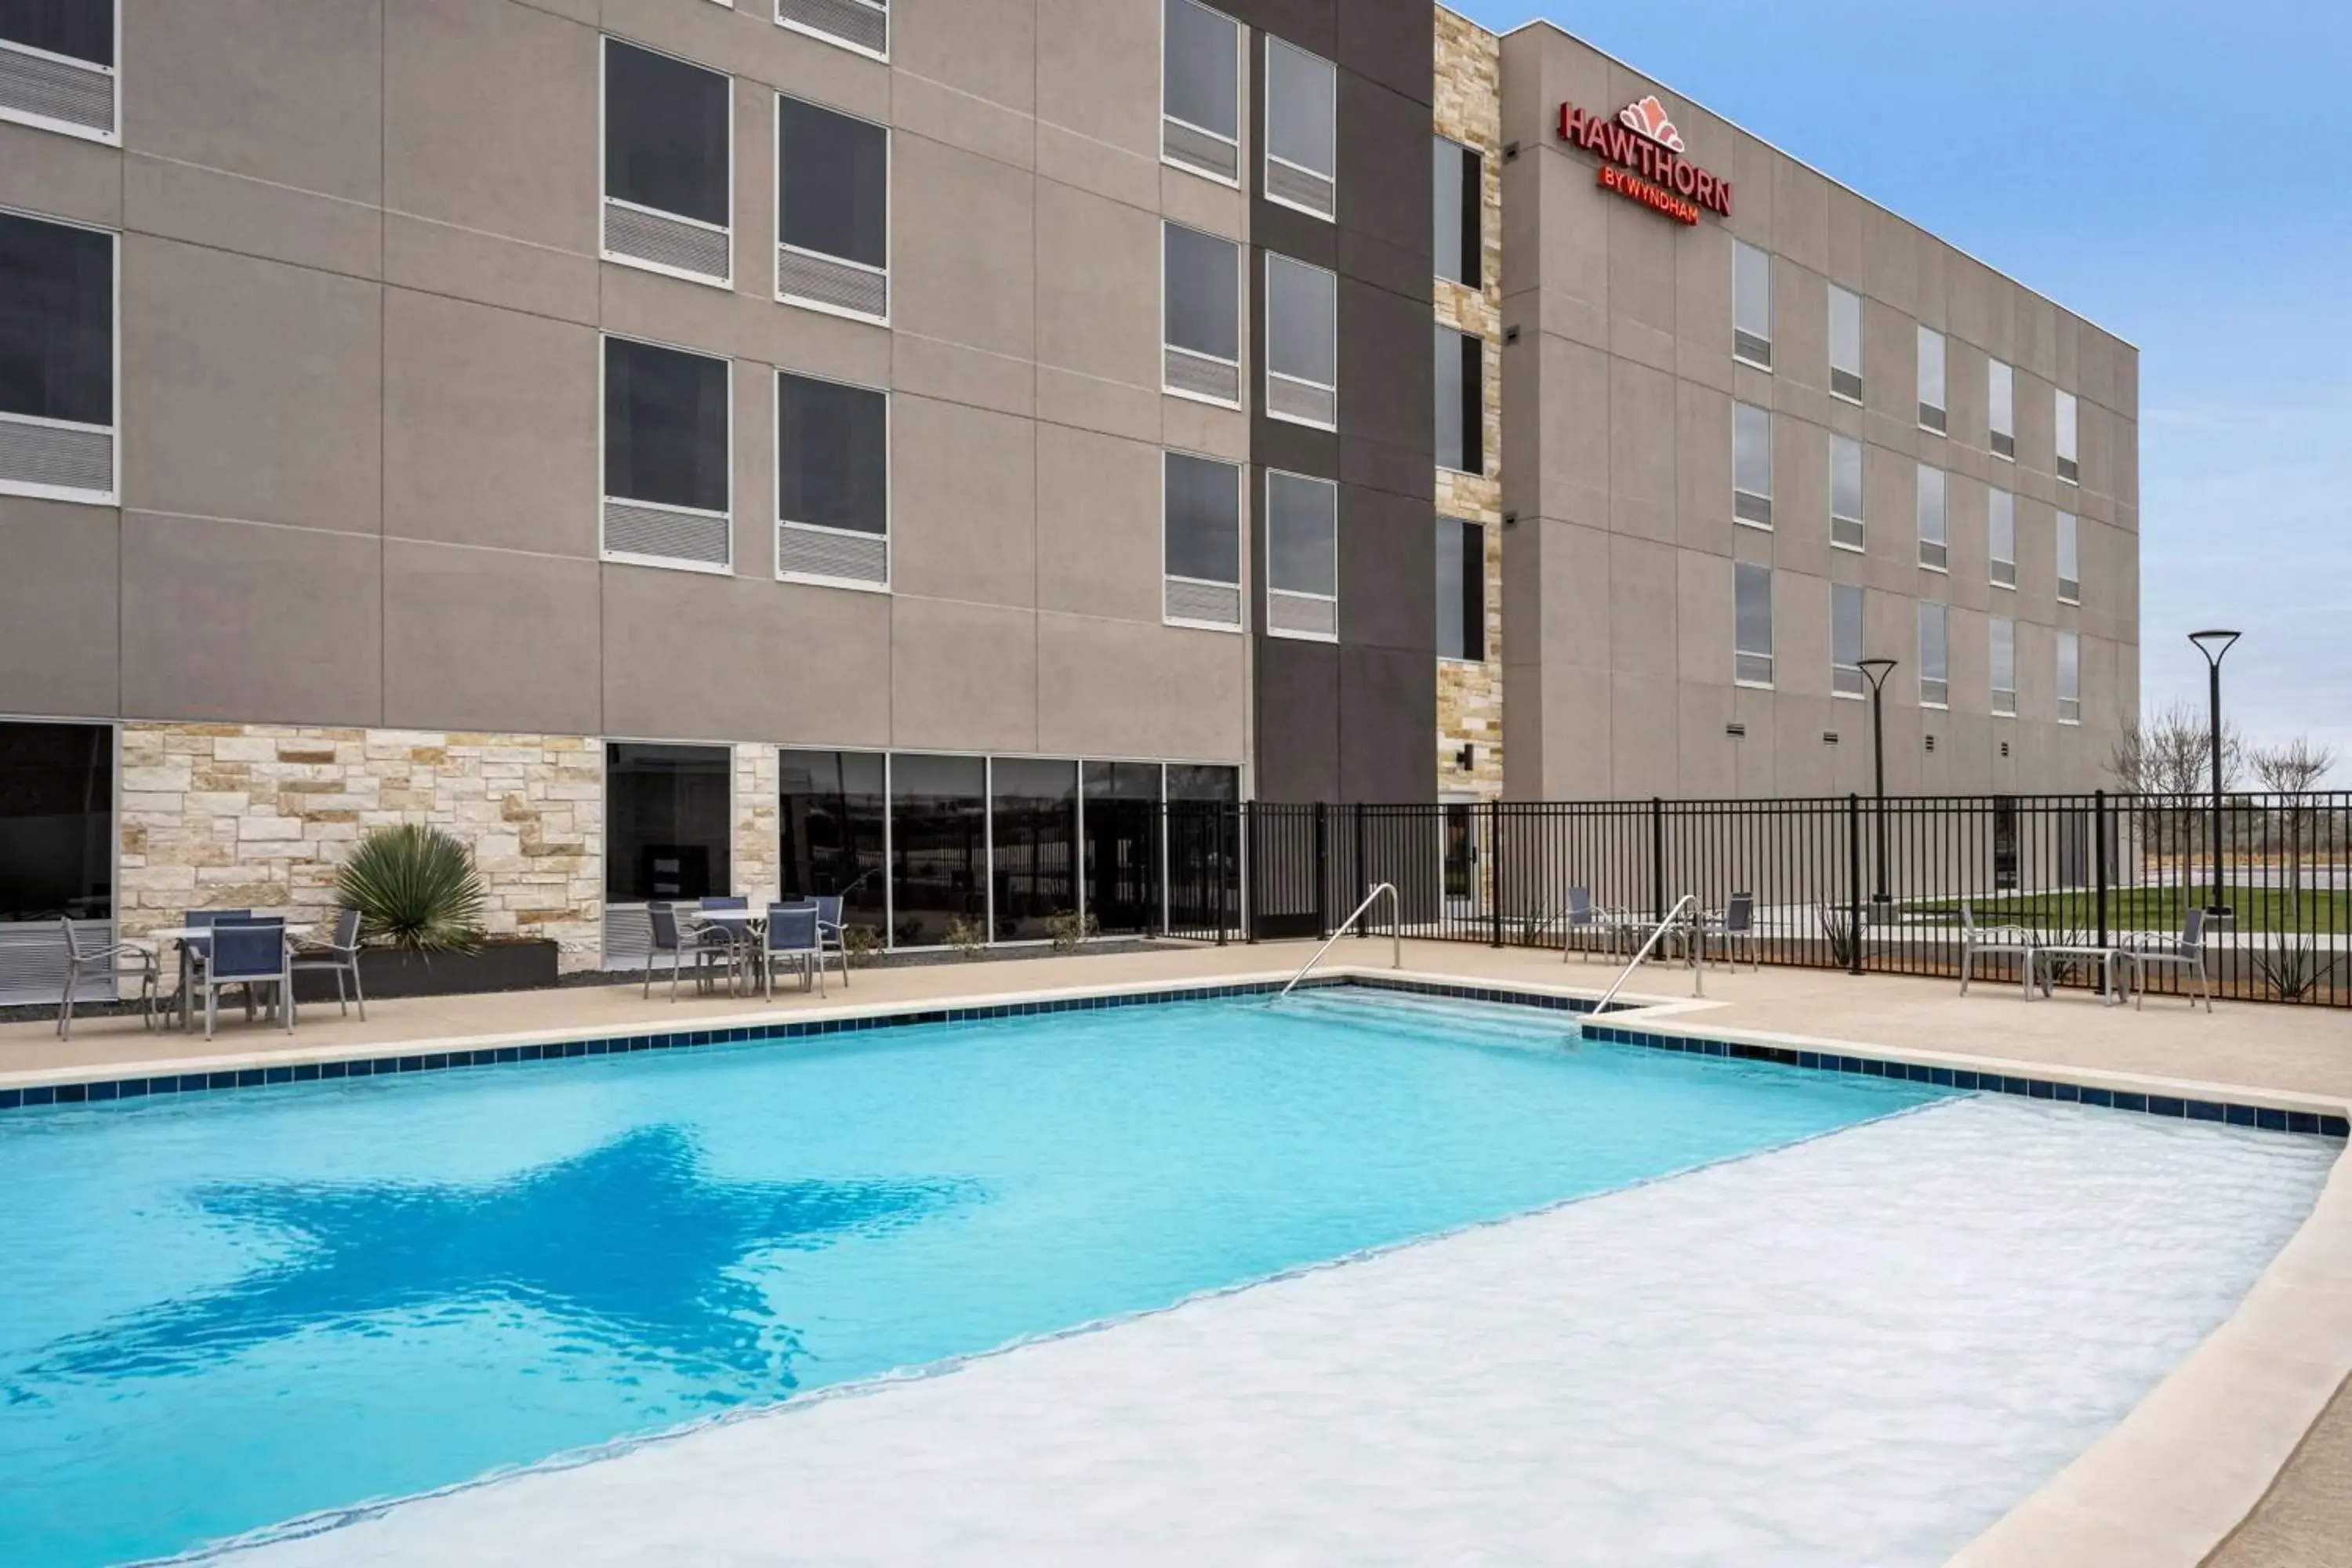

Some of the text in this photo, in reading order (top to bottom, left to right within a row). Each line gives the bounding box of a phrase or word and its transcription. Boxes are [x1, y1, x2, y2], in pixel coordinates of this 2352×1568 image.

[1559, 101, 1732, 216] HAWTHORN
[1603, 165, 1699, 224] BY WYNDHAM
